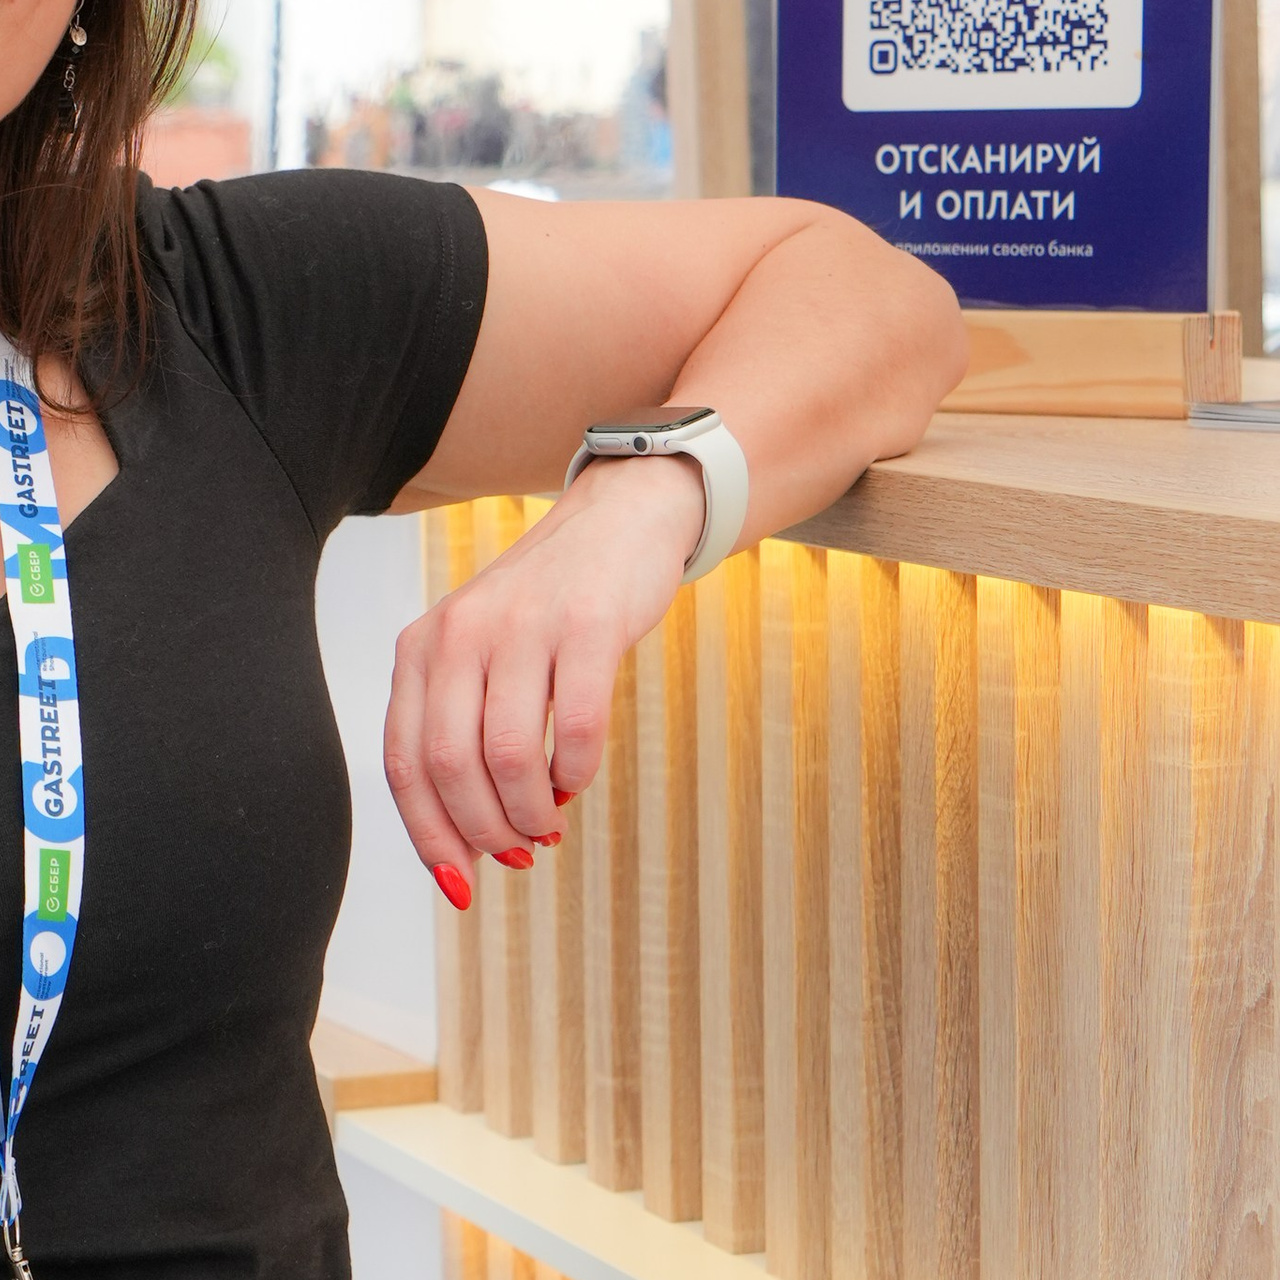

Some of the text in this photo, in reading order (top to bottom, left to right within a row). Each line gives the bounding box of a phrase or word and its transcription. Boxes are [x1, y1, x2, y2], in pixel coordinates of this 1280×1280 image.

[875, 136, 1101, 175] ОТСКАНИРУЙ
[900, 189, 1075, 221] И ОПЛАТИ
[992, 242, 1045, 257] своего
[1048, 239, 1094, 257] банка
[6, 401, 38, 519] GASTREET
[29, 550, 41, 581] СБЕР
[38, 675, 64, 817] GASTREET
[49, 857, 60, 894] СБЕР
